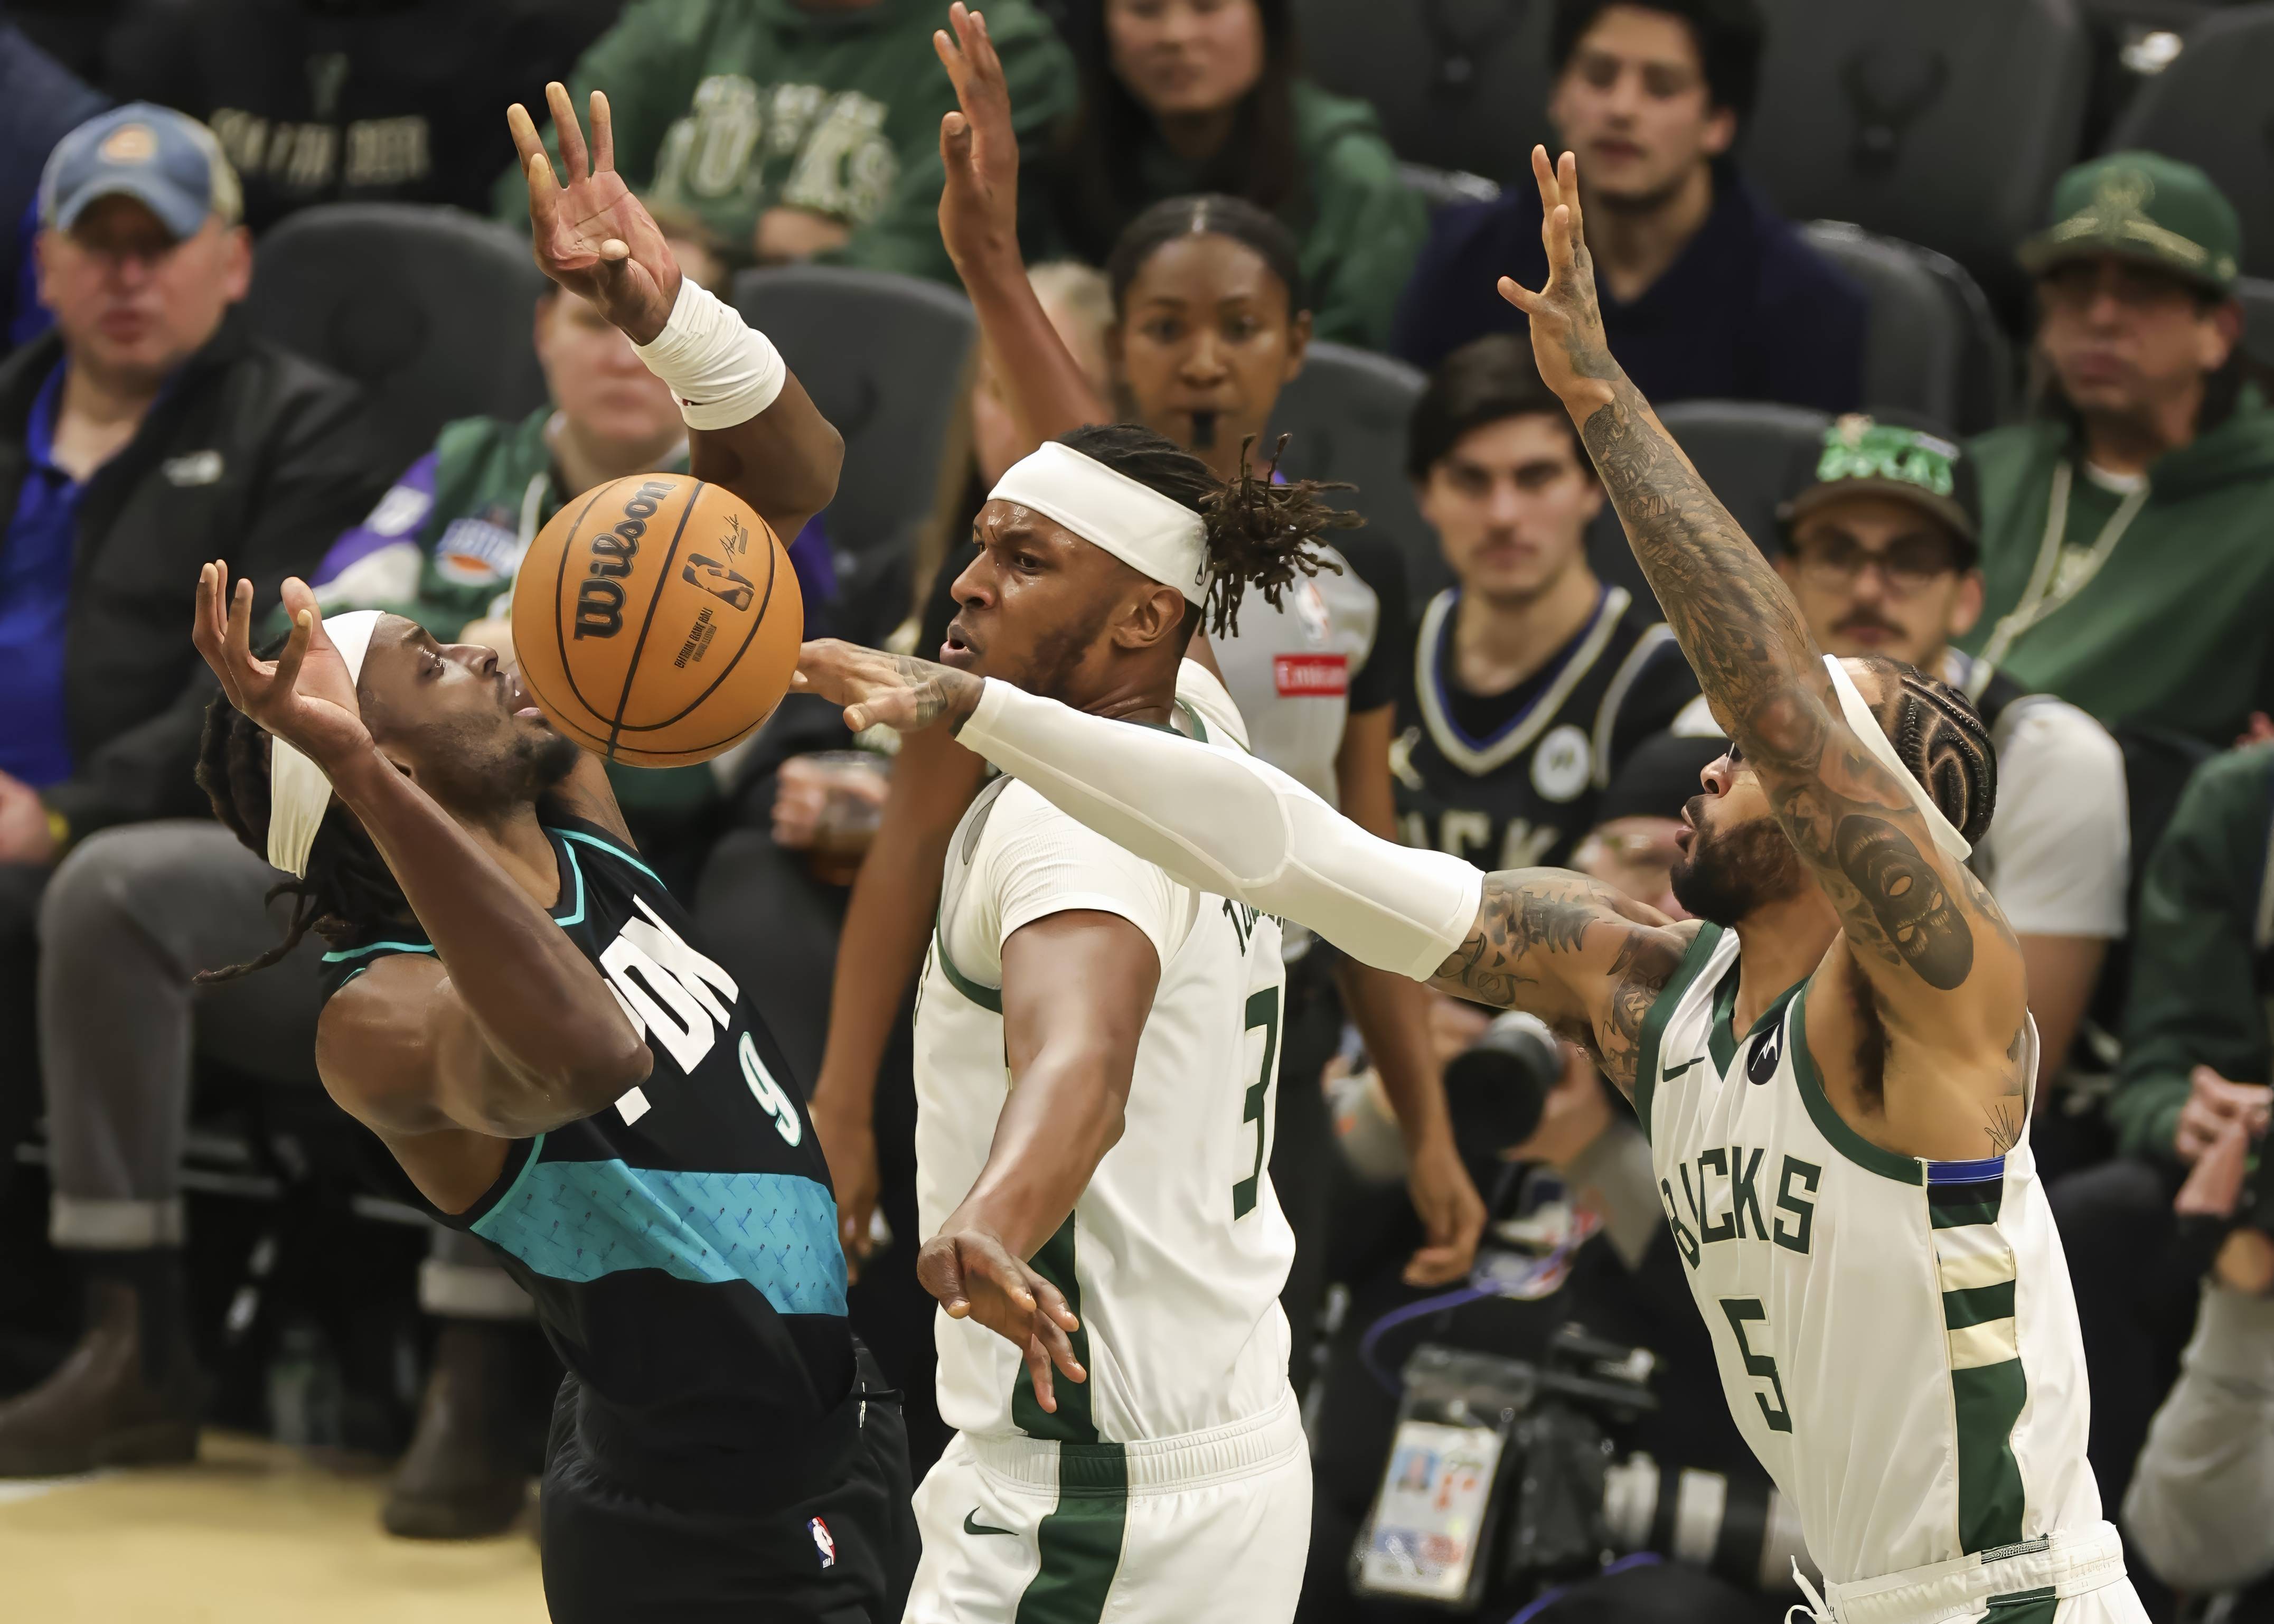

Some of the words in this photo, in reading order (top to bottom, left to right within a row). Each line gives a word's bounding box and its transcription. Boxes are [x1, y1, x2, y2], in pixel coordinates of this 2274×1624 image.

[573, 481, 677, 642] Wilson
[738, 1031, 802, 1147] 9
[1718, 1297, 1793, 1434] 5
